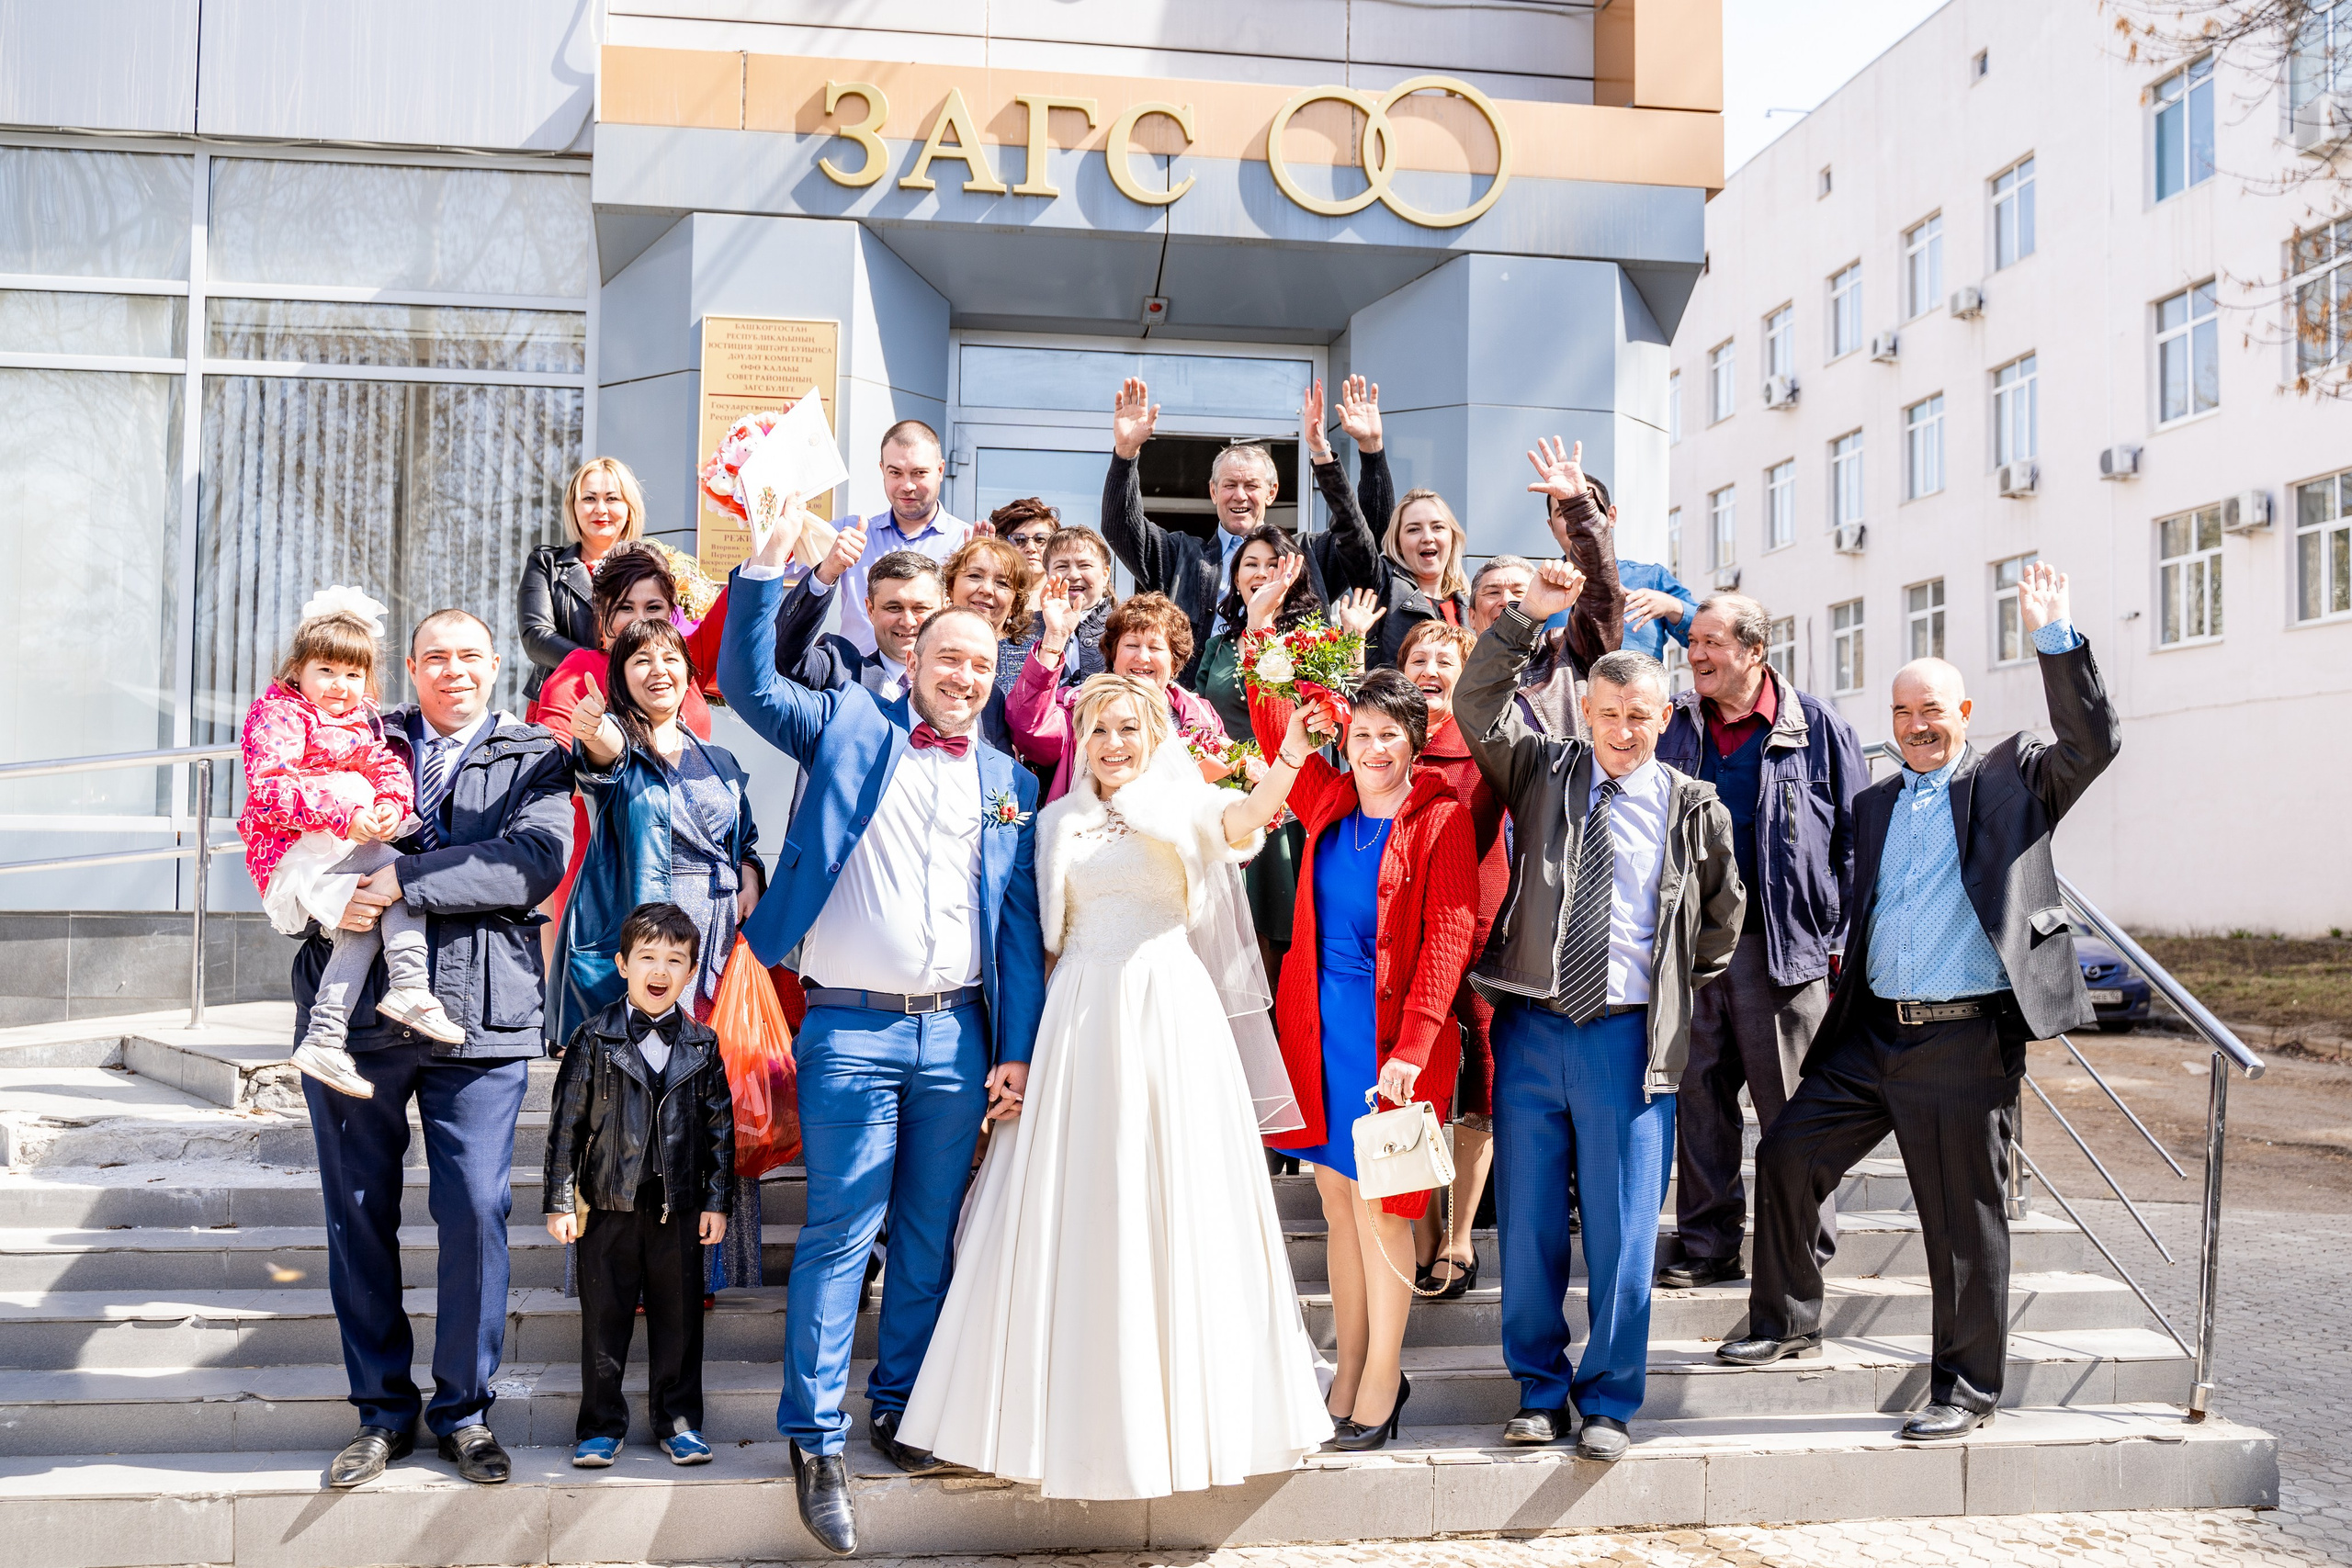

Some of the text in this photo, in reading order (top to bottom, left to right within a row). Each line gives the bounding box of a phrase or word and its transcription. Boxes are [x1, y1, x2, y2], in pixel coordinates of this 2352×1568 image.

[819, 80, 1196, 205] ЗАГС
[708, 342, 752, 350] ЮСТИЦИЯ
[764, 355, 813, 363] КОМИТЕТЫ
[726, 373, 753, 381] СОВЕТ
[711, 401, 783, 412] Государственны
